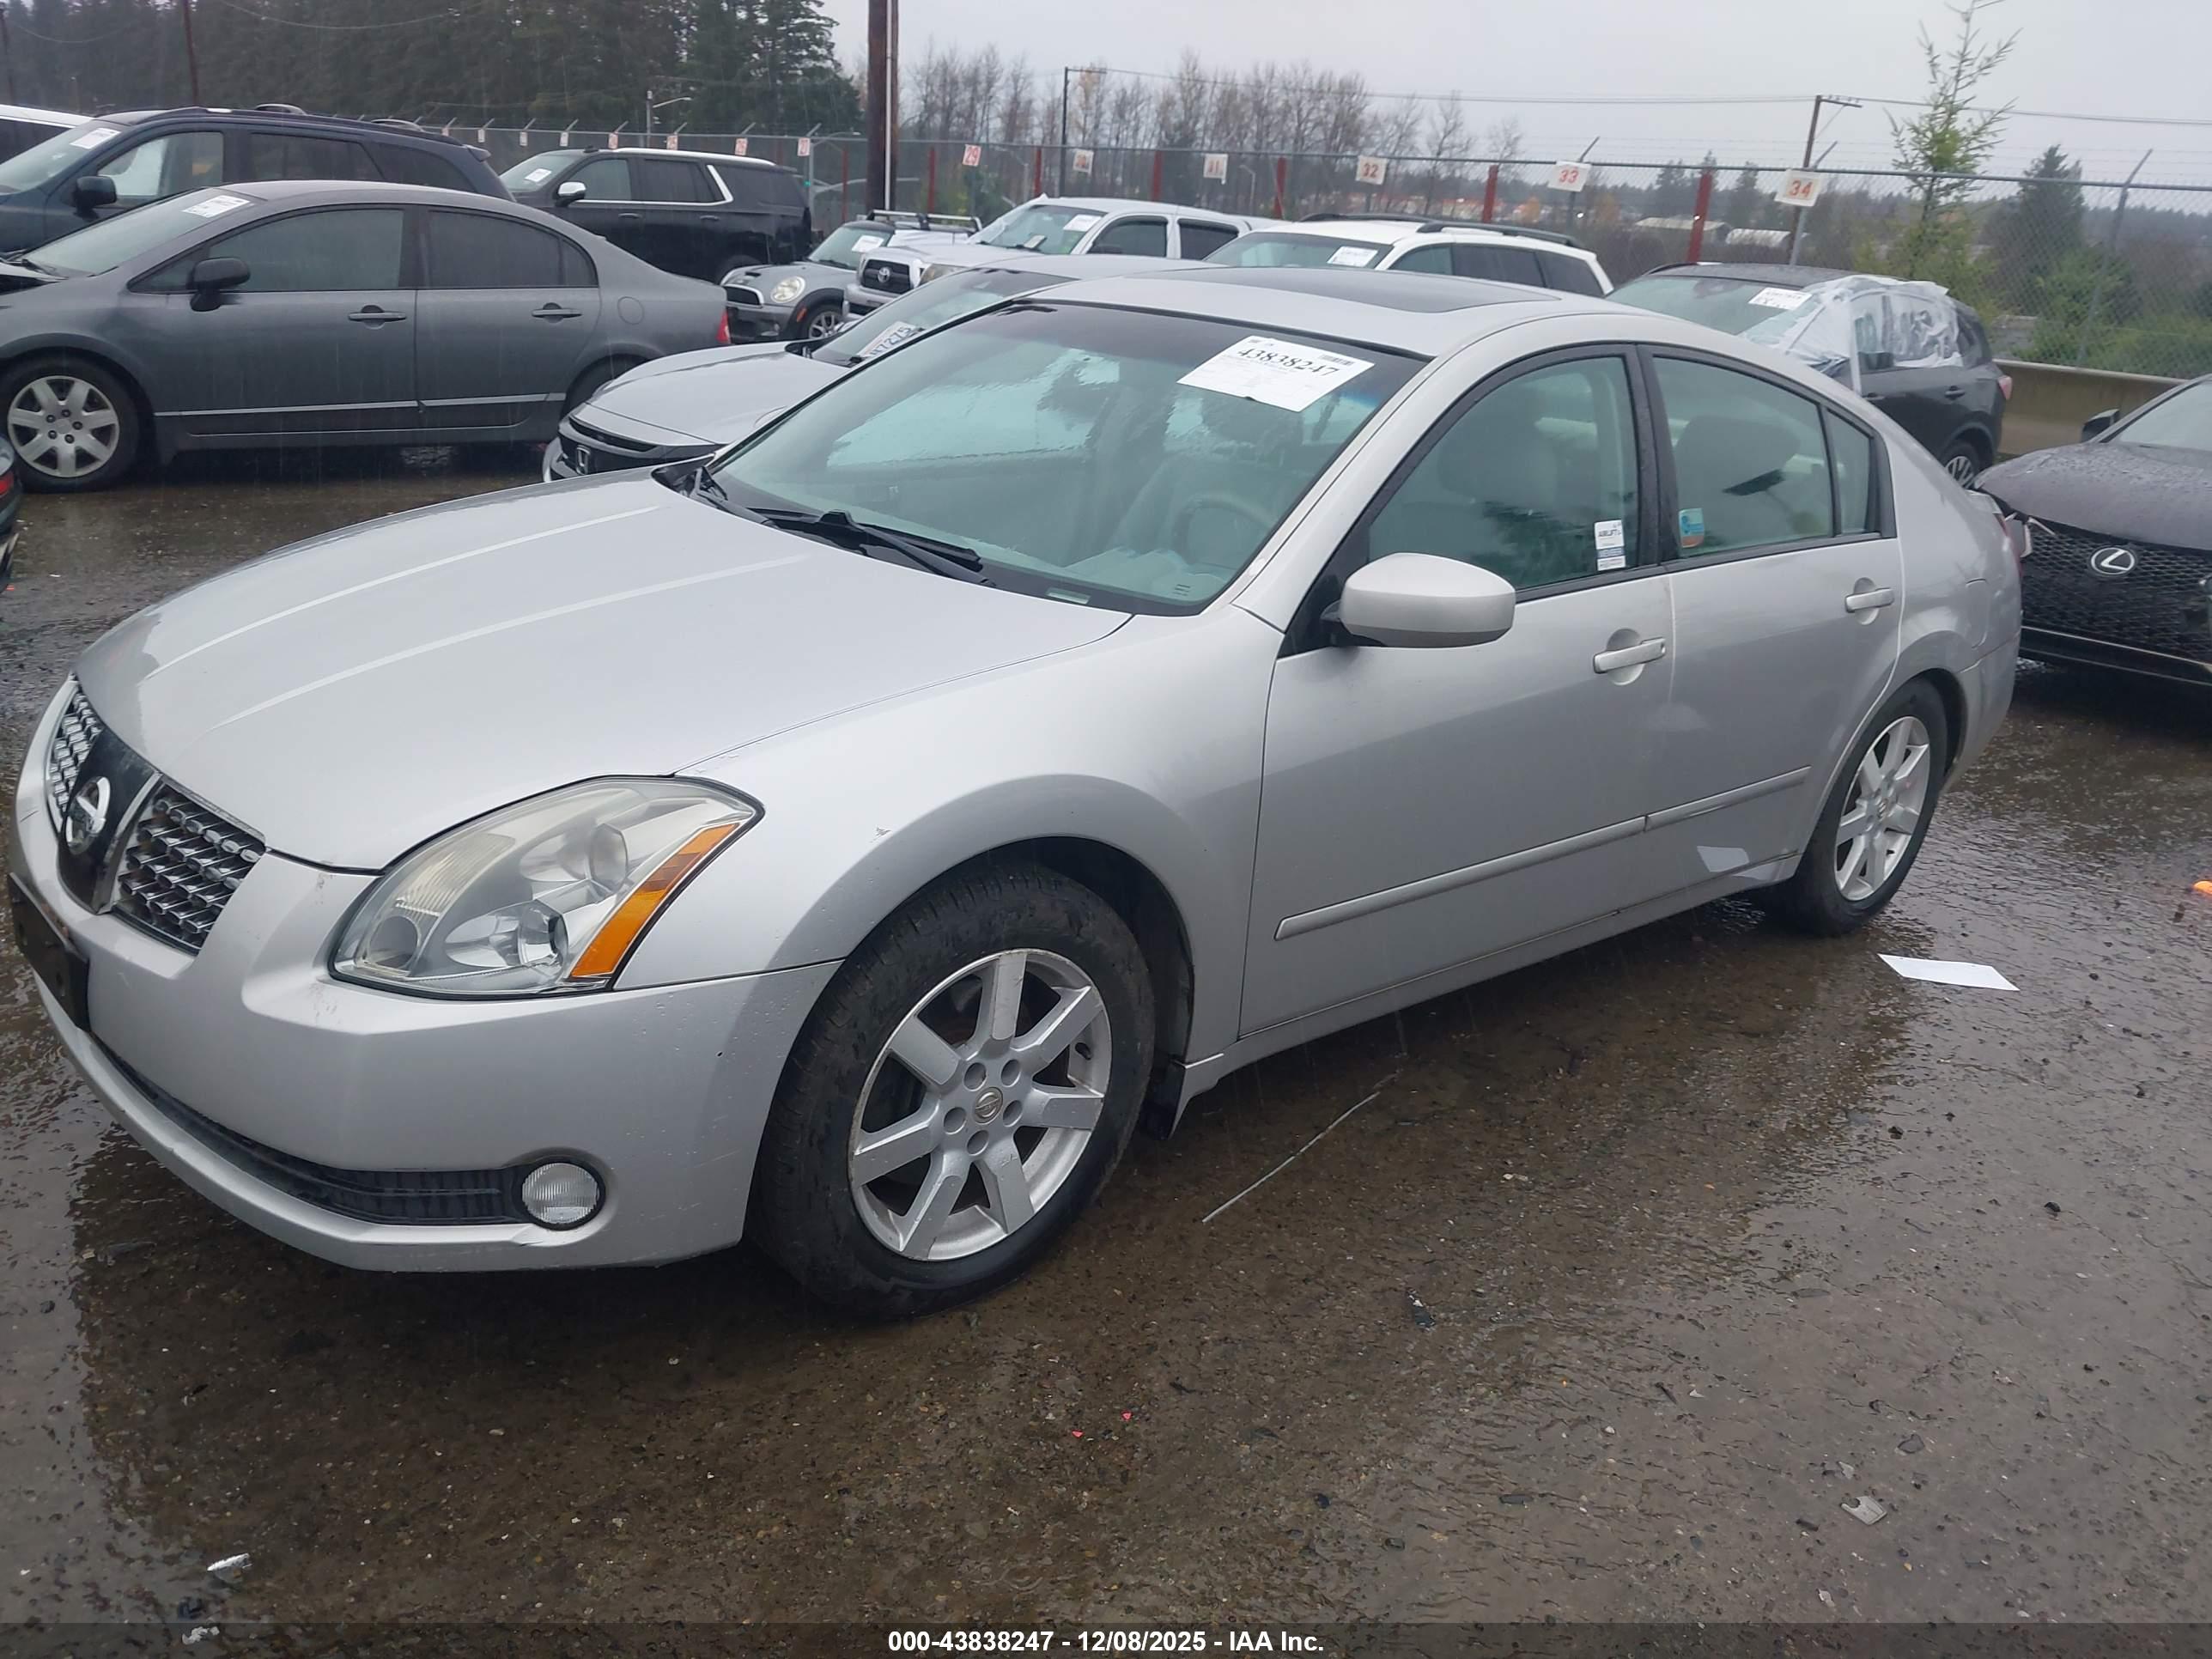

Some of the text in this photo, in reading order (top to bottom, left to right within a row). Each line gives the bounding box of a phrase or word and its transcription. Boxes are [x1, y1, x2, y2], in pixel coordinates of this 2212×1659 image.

[964, 146, 979, 165] 29
[1363, 162, 1379, 179] 32
[1559, 167, 1578, 184] 33
[1790, 179, 1811, 198] 34
[1237, 347, 1340, 377] 43838247
